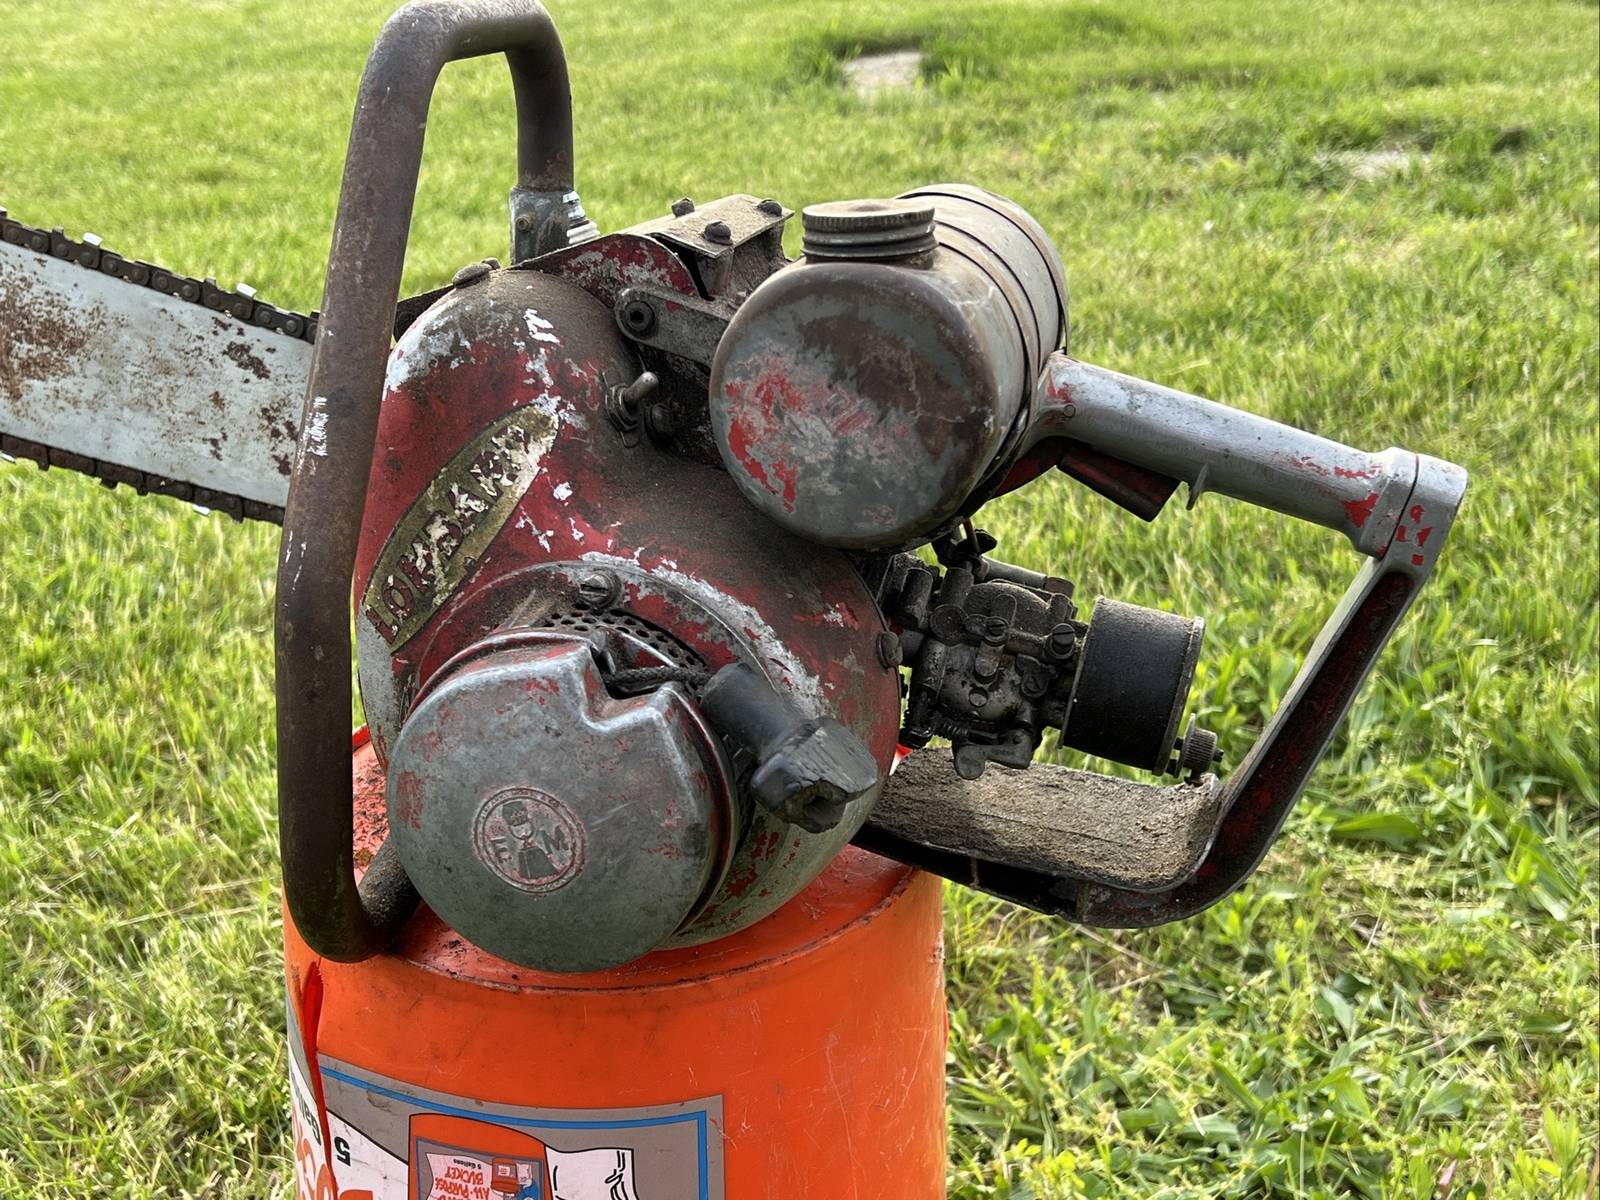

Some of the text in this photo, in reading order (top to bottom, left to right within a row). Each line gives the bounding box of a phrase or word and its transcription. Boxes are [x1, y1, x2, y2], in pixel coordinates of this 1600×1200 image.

[334, 1136, 351, 1167] 5
[453, 1158, 476, 1169] Gallons
[444, 1166, 484, 1186] BUCKET
